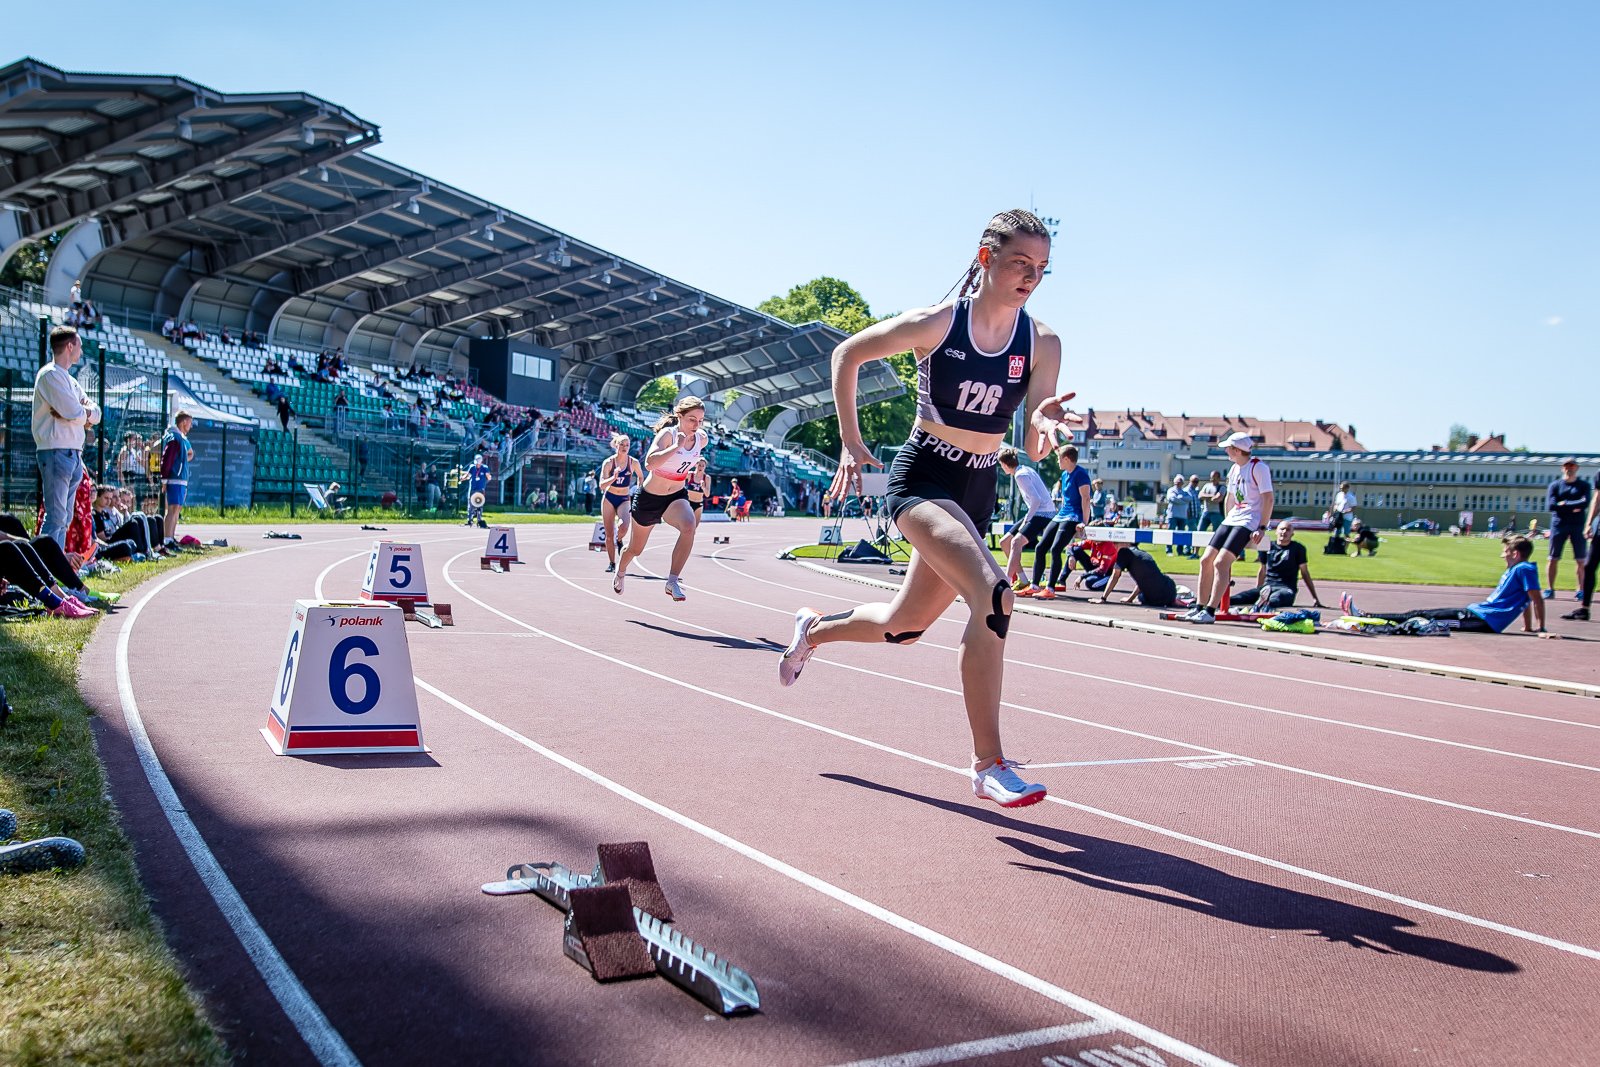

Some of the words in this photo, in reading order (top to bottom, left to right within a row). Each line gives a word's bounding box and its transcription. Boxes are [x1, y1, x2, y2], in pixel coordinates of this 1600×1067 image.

[944, 347, 967, 361] esa
[956, 380, 1003, 416] 126
[921, 435, 964, 462] PRO
[494, 533, 509, 554] 4
[598, 526, 606, 541] 3
[824, 529, 832, 542] 2
[389, 555, 412, 589] 5
[339, 615, 384, 628] polanik
[280, 630, 299, 706] 6
[328, 635, 381, 715] 6
